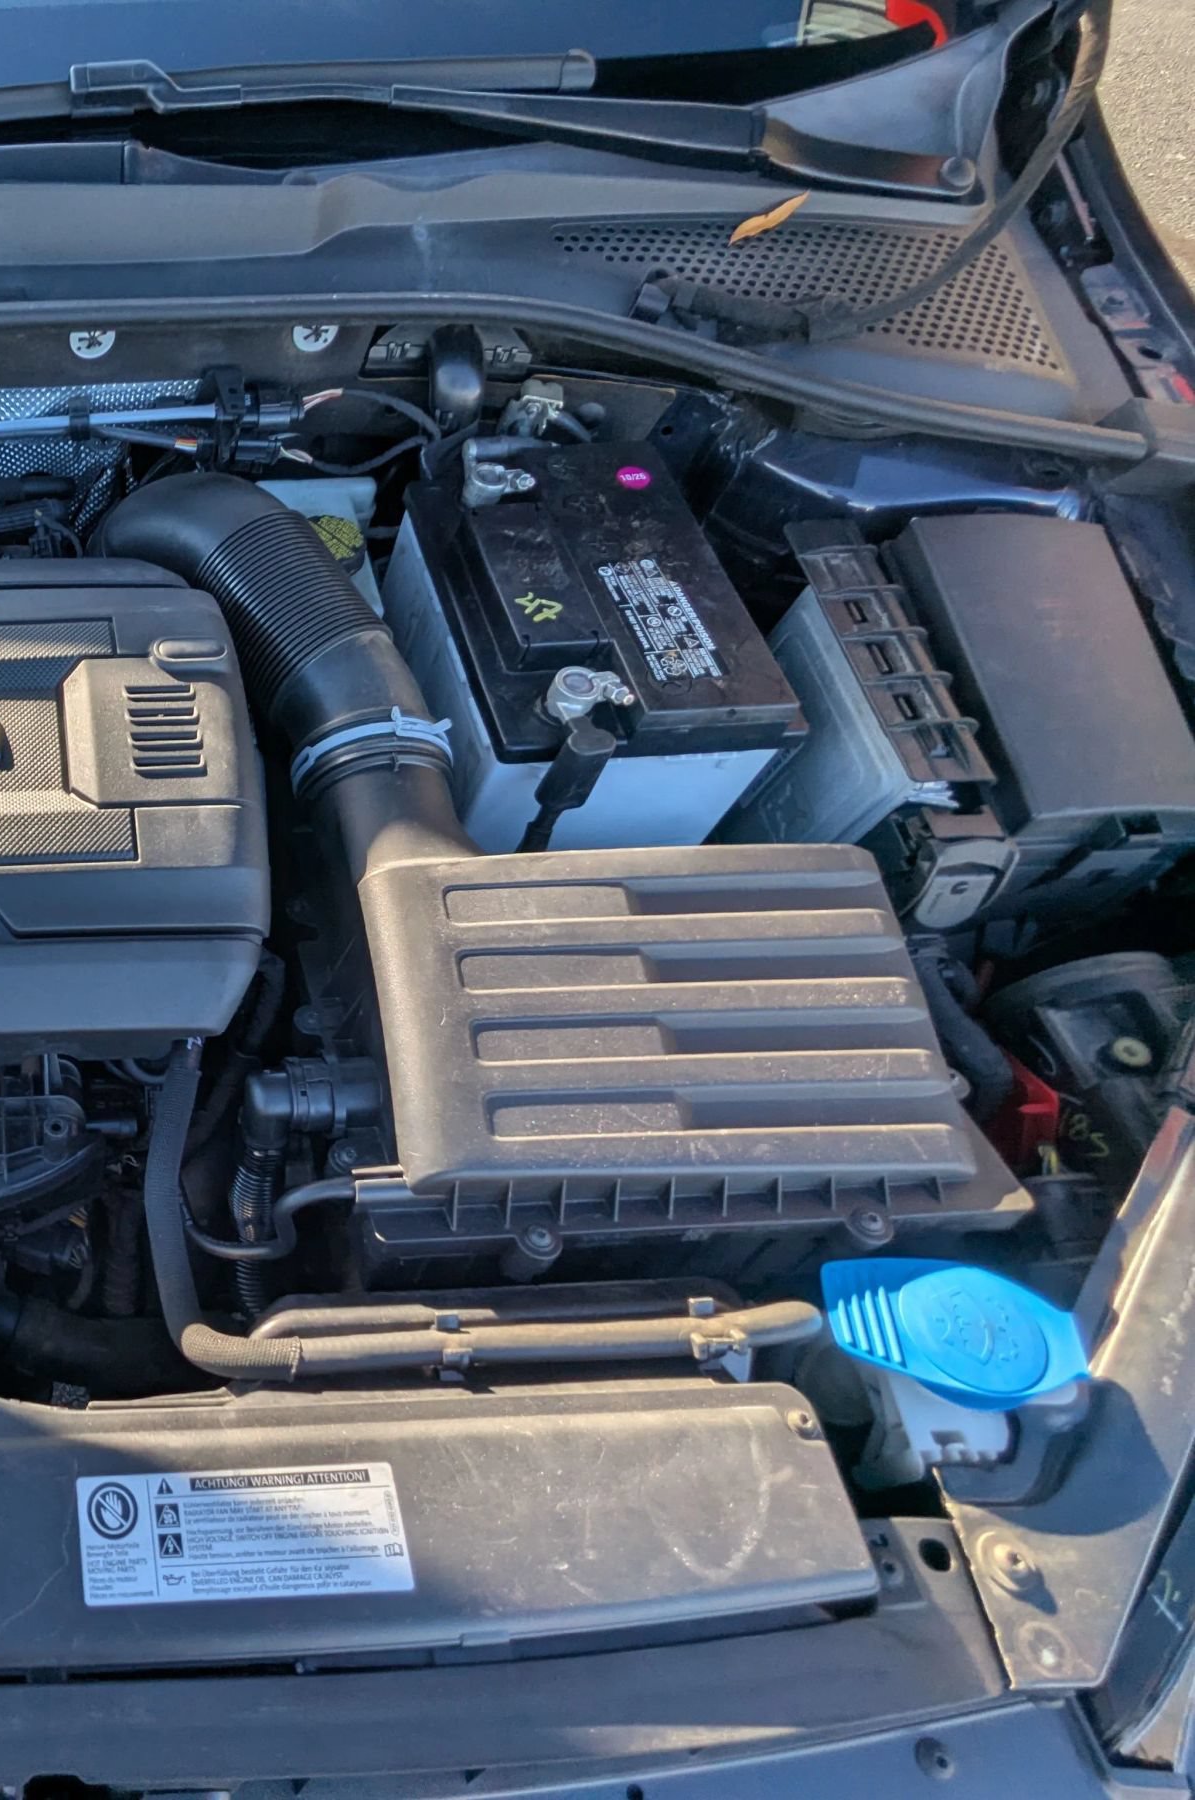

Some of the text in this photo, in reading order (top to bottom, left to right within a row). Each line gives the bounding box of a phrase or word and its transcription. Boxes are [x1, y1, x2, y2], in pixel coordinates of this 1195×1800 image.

[195, 1471, 366, 1489] ACHTUNG! WARNING! ATTENTION!
